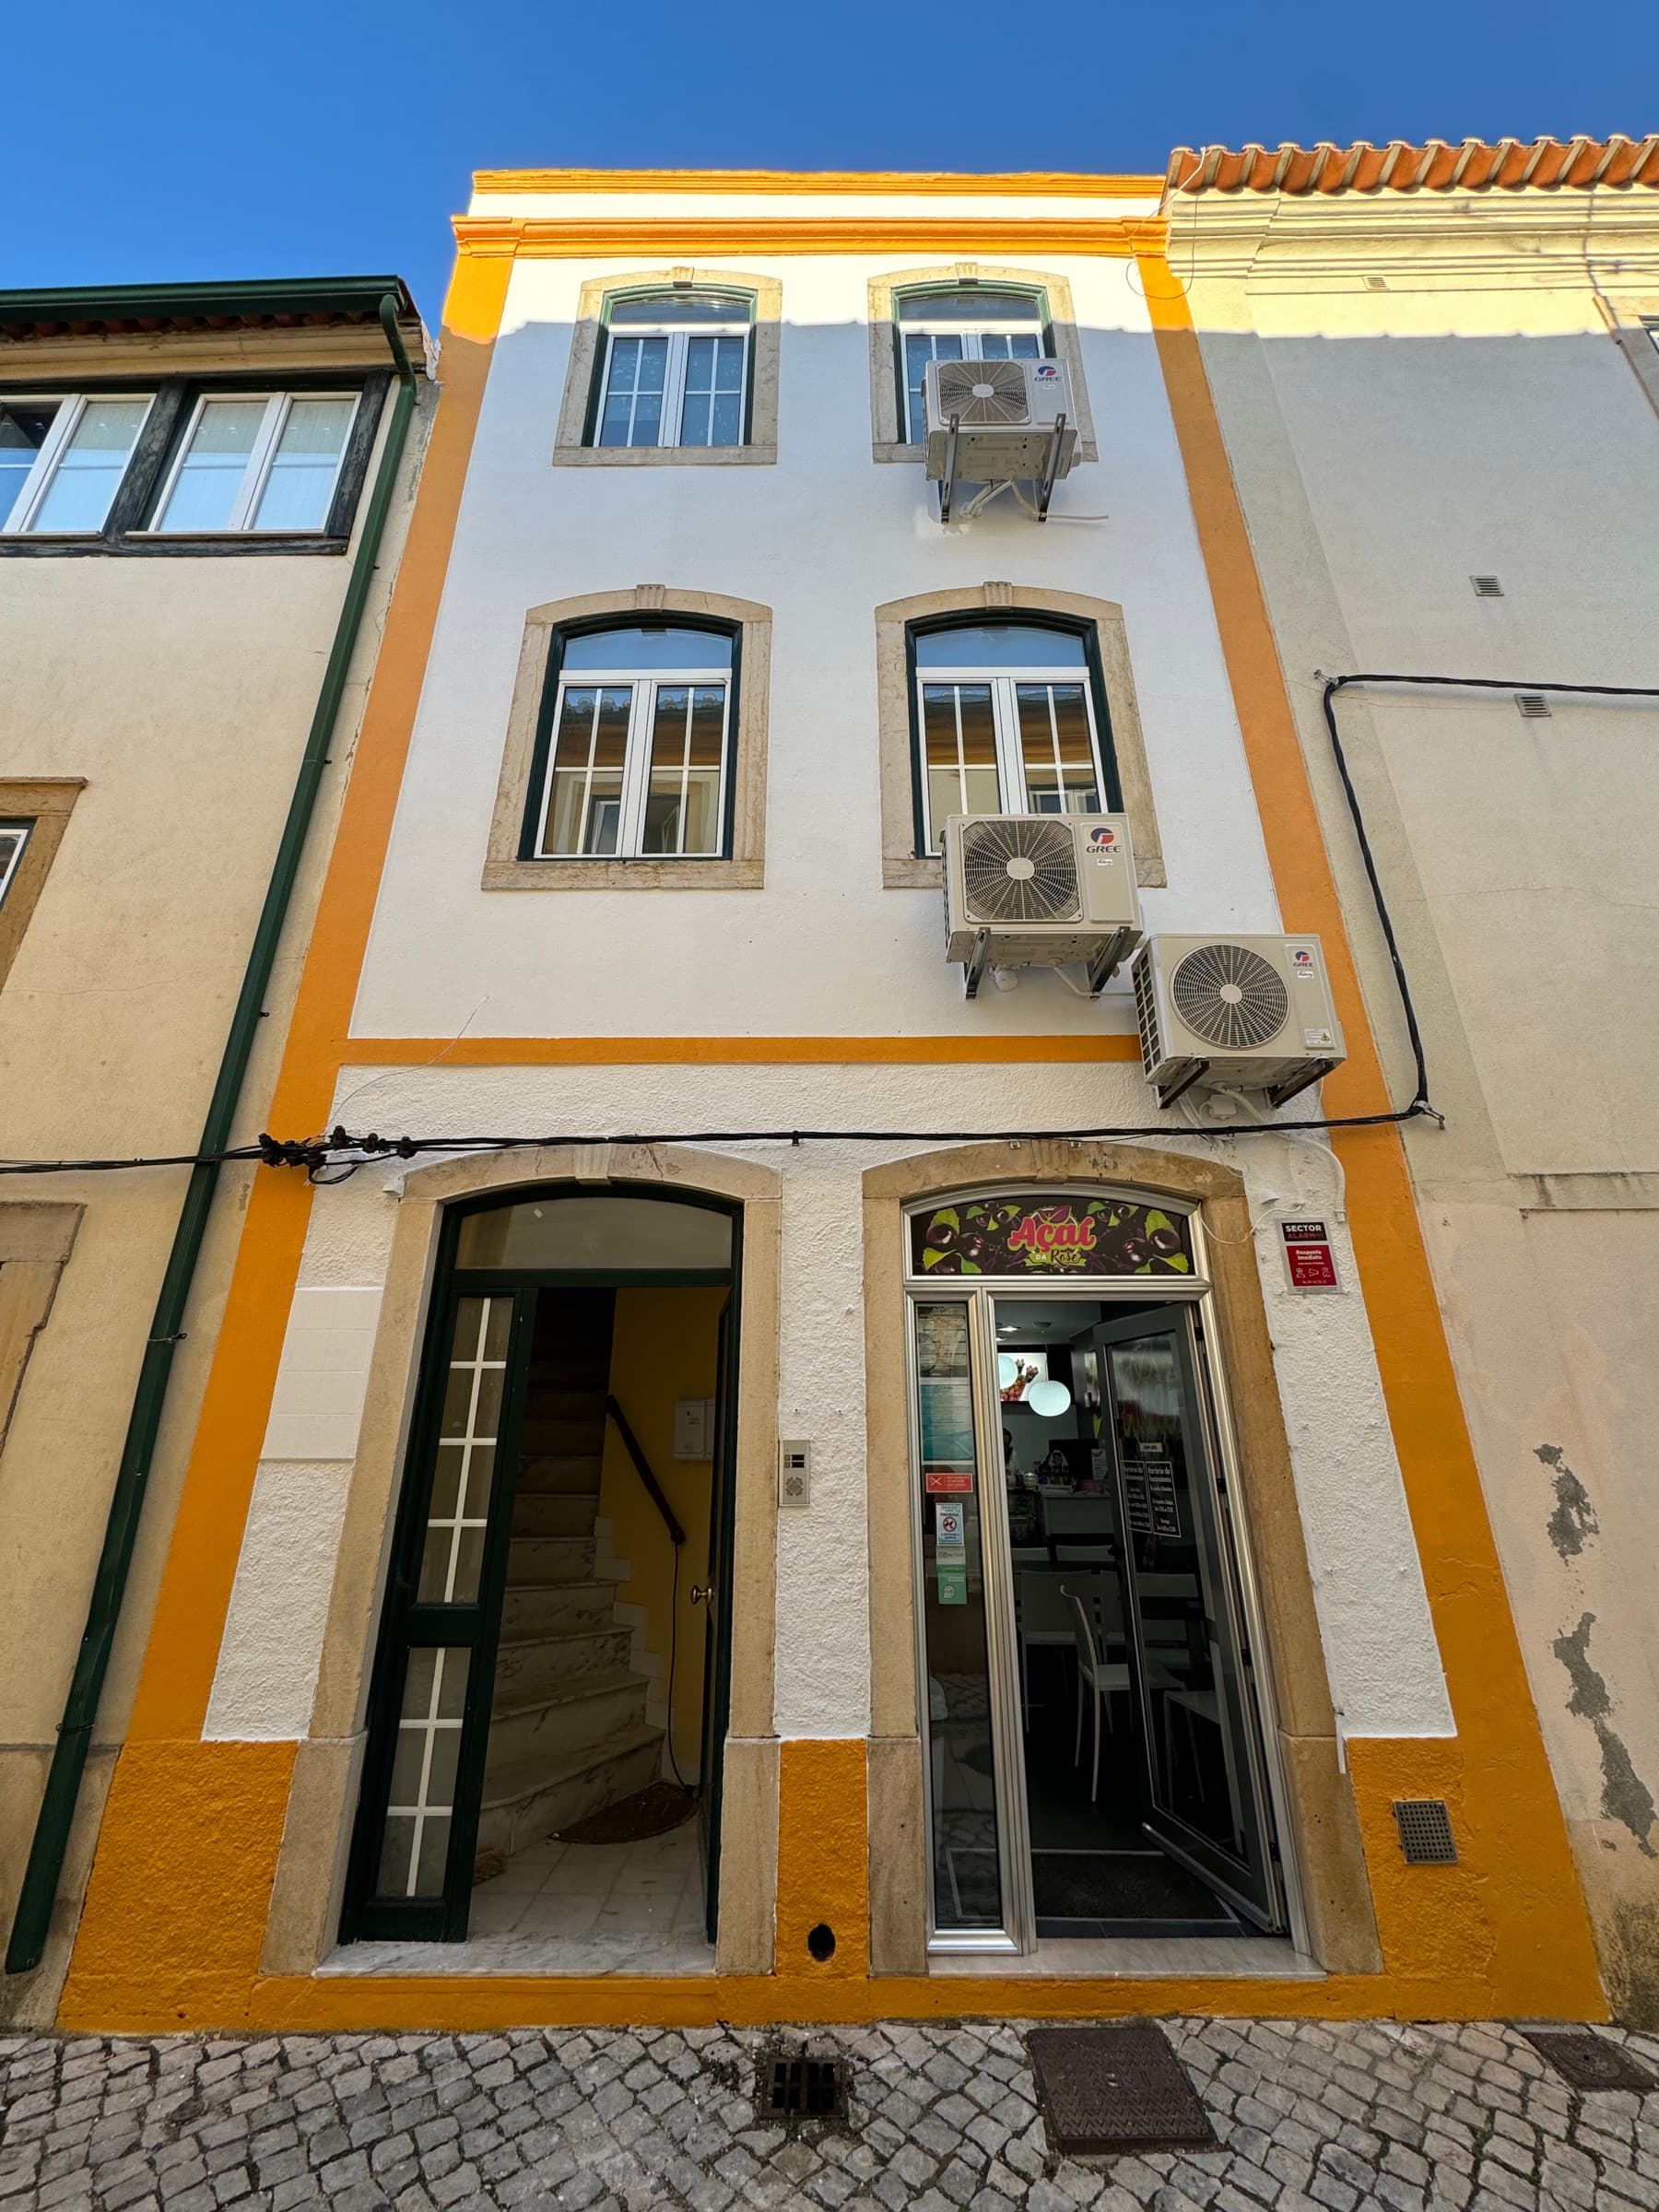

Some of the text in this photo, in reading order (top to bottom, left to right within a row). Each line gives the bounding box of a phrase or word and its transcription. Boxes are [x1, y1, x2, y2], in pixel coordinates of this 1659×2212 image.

[1086, 845, 1122, 853] GREE
[1285, 1224, 1322, 1232] SECTOR
[1008, 1217, 1096, 1253] Açaí
